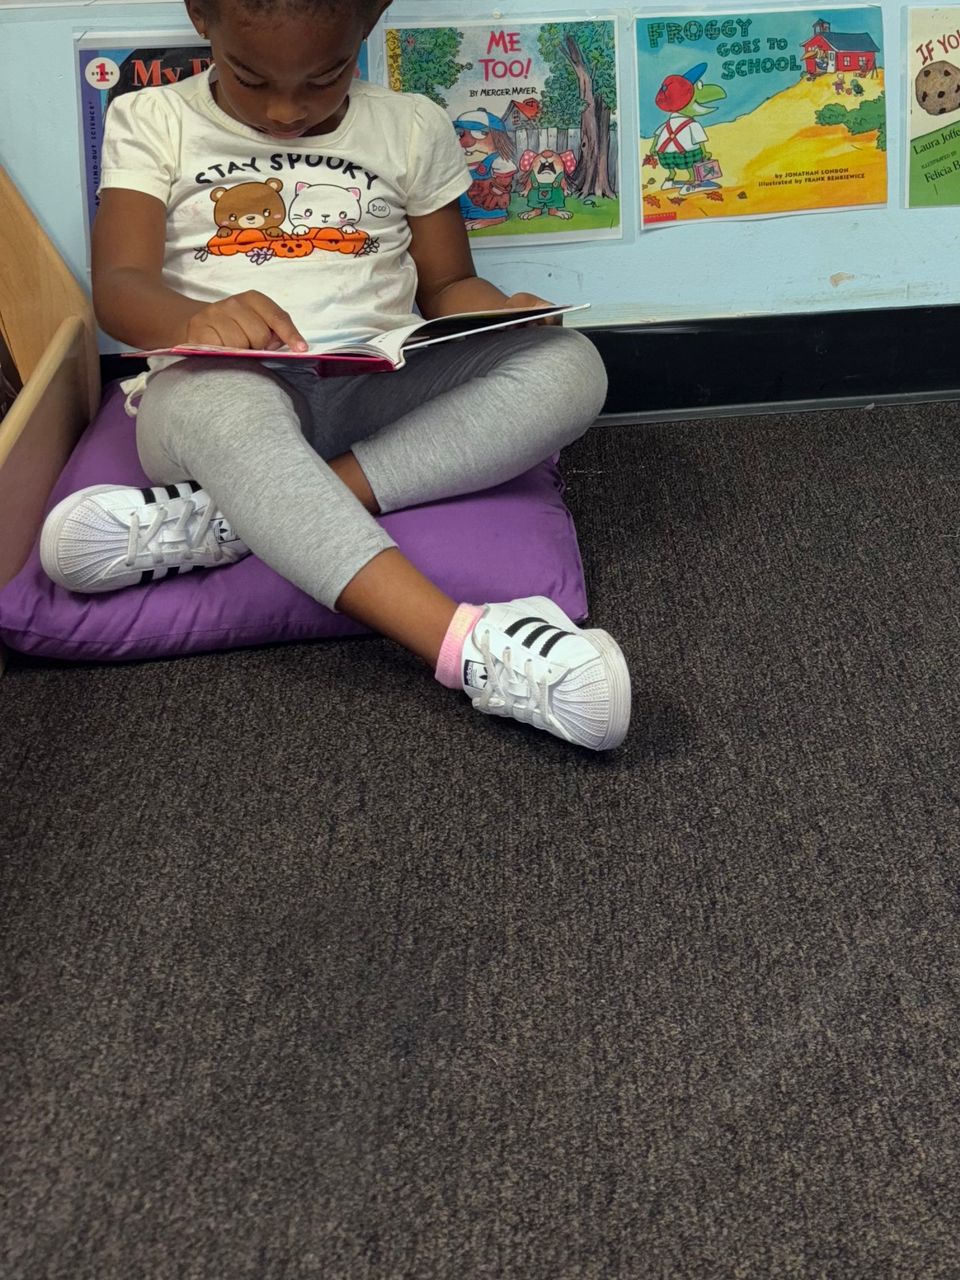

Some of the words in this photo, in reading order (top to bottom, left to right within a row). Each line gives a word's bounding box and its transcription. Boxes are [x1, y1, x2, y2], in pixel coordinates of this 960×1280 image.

[487, 30, 522, 55] ME
[647, 18, 752, 48] FROGGY
[717, 38, 761, 57] GOES
[767, 37, 788, 50] TO
[916, 40, 935, 65] IF
[96, 63, 109, 82] 1
[131, 59, 184, 87] My
[478, 58, 532, 81] TOO!
[721, 55, 802, 80] SCHOOL
[469, 89, 479, 97] BY
[480, 88, 511, 96] MERCER
[511, 86, 538, 96] MAYER
[913, 138, 940, 155] Laura
[941, 128, 960, 144] Joffe
[195, 156, 262, 185] STAY
[270, 153, 379, 190] SPOOKY
[924, 166, 953, 183] Felicia
